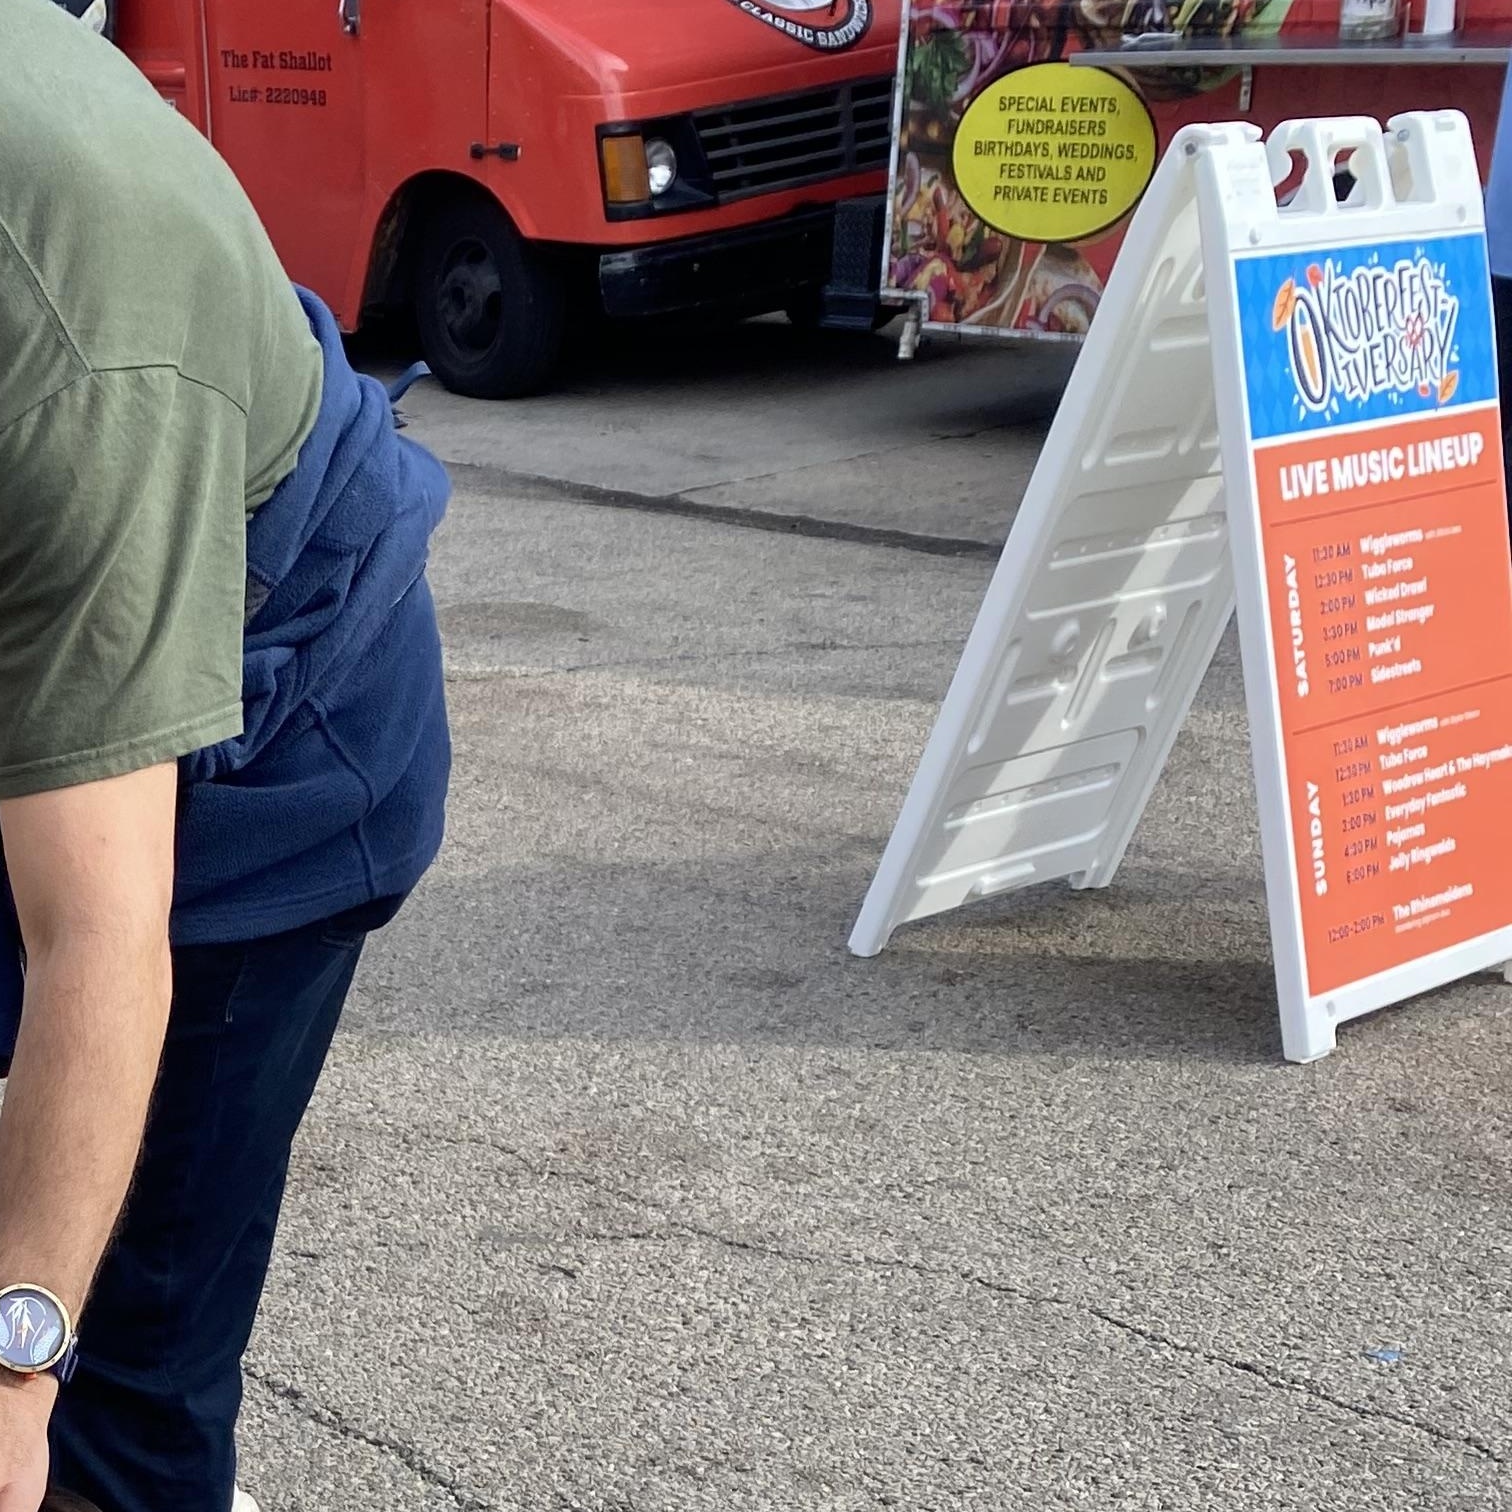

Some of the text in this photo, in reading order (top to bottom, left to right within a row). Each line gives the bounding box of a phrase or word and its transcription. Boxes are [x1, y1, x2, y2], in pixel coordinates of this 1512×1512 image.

[739, 1, 814, 42] CLASSIC
[221, 50, 332, 72] The Fat Shallot
[265, 87, 327, 106] 2220948
[999, 96, 1120, 116] SPECIAL EVENTS,
[1007, 119, 1106, 136] FUNDRAISERS
[974, 140, 1138, 162] BIRTHDAYS, WEDDINGS,
[1000, 163, 1106, 182] FESTIVALS AND
[994, 186, 1108, 205] PRIVATE EVENTS
[1280, 432, 1483, 501] LIVE MUSIC LINEUP
[1336, 543, 1351, 556] AM
[1315, 572, 1337, 588] 12:30
[1339, 569, 1353, 583] PM
[1387, 557, 1414, 575] Force
[1342, 595, 1355, 609] PM
[1364, 583, 1400, 605] Wicked
[1284, 554, 1309, 697] SATURDAY
[1345, 621, 1358, 636] PM
[1347, 649, 1360, 663] PM
[1328, 677, 1347, 693] 7:00
[1349, 674, 1363, 688] PM
[1355, 736, 1368, 750] AM
[1358, 761, 1371, 775] PM
[1361, 786, 1374, 801] PM
[1456, 756, 1472, 772] The
[1363, 813, 1376, 827] PM
[1307, 781, 1327, 896] SUNDAY
[1364, 837, 1378, 851] PM
[1367, 863, 1380, 878] PM
[1372, 913, 1385, 928] PM
[1392, 903, 1410, 921] The
